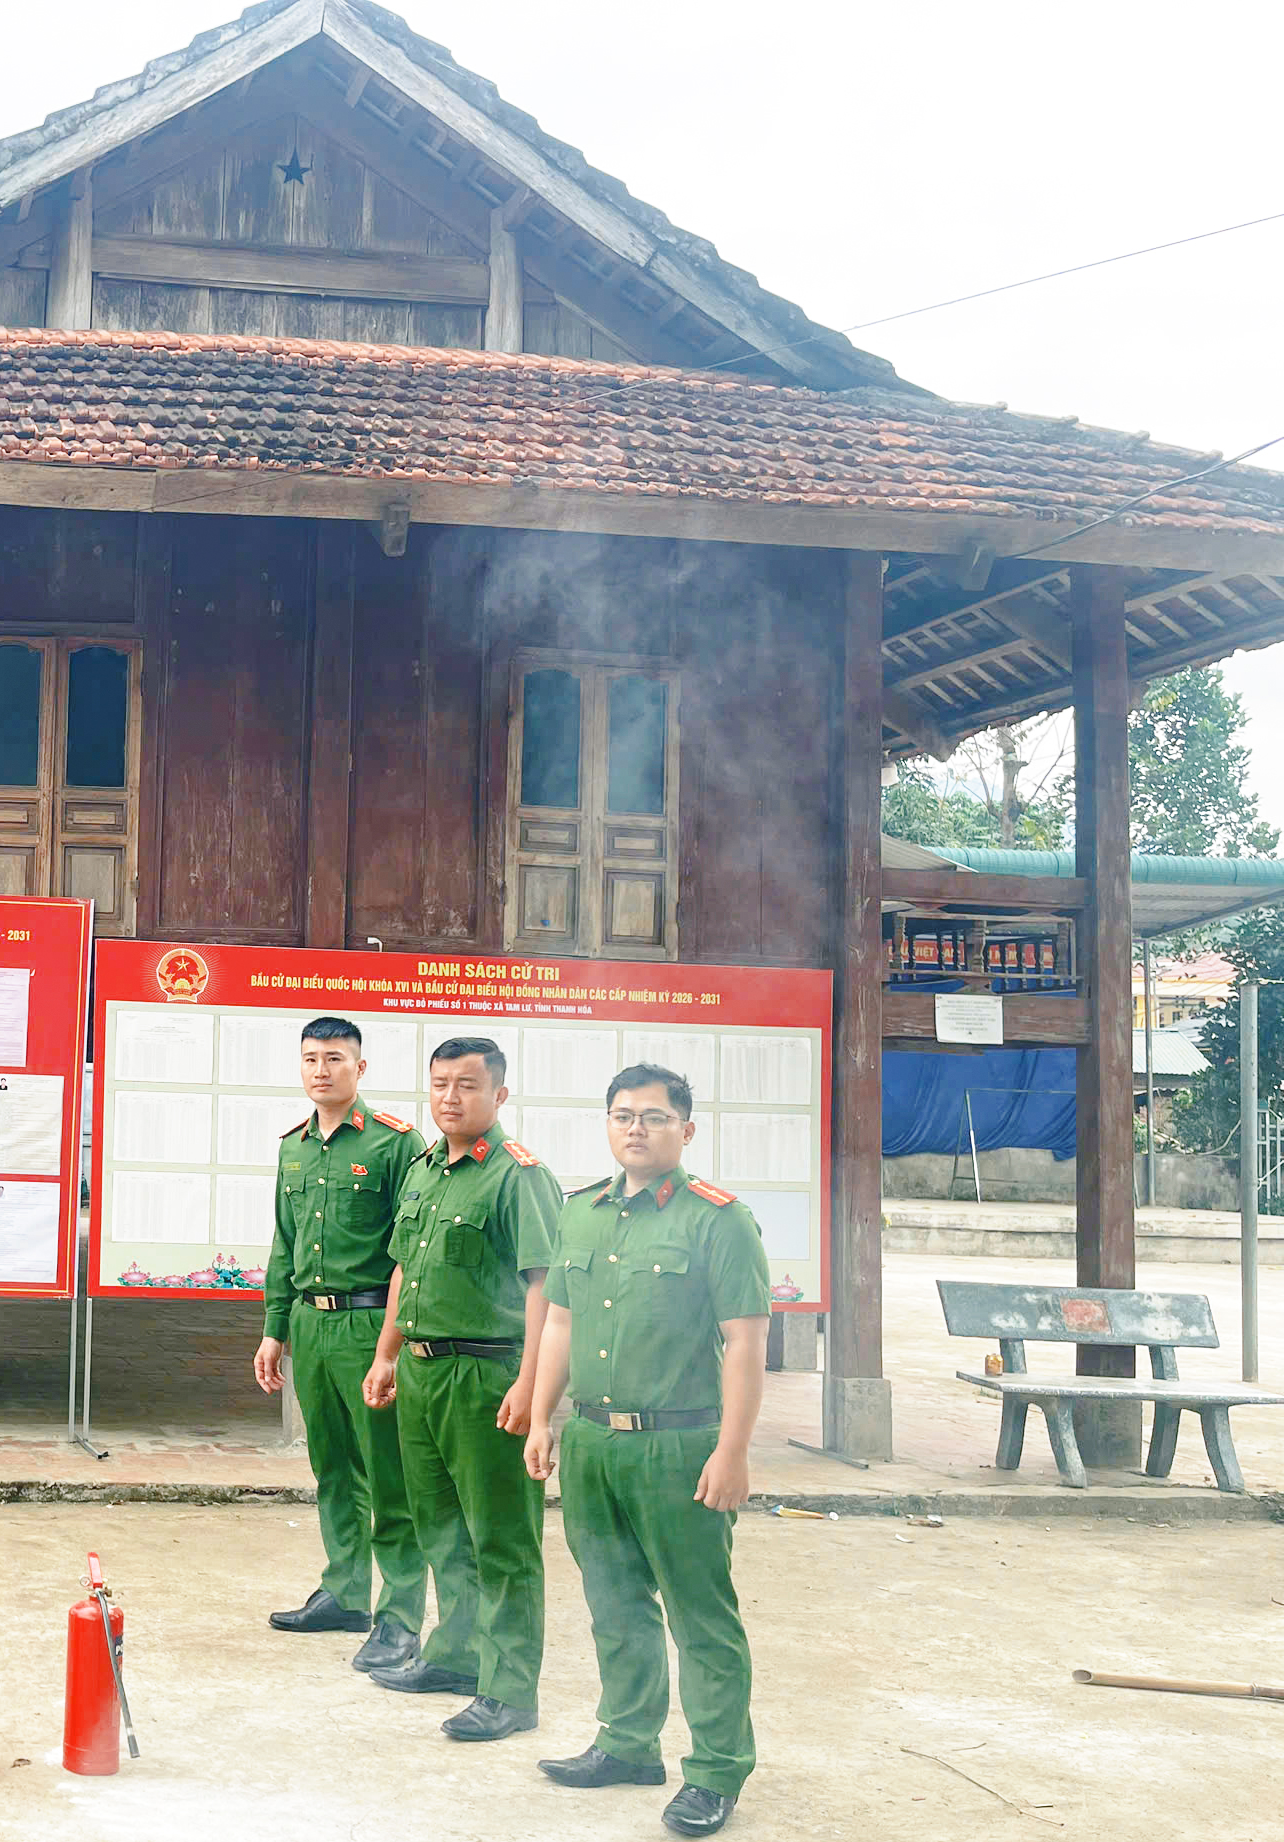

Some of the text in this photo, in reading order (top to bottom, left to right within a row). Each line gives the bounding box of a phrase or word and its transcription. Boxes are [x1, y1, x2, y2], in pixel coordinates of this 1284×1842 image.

[8, 930, 30, 941] 2031
[418, 962, 560, 980] DANH SÁCH CỬ TRI
[272, 973, 285, 988] CỬ
[286, 977, 301, 991] ĐẠI
[303, 974, 323, 990] BIỂU
[326, 976, 350, 991] QUỐC
[352, 978, 366, 992] HỘI
[369, 979, 392, 992] KHÓA
[395, 982, 410, 992] XVI
[412, 980, 422, 993] VÀ
[446, 980, 459, 995] CỬ
[460, 984, 474, 996] ĐẠI
[477, 980, 496, 996] BIỂU
[500, 984, 514, 998] HỘI
[542, 984, 567, 999] NHÂN
[569, 986, 586, 1000] DÂN
[589, 986, 607, 1001] CÁC
[609, 986, 626, 1001] CẤP
[628, 989, 656, 1004] NHIỆM
[659, 990, 670, 1003] KỲ
[672, 993, 692, 1004] 2026
[700, 994, 720, 1005] 2031
